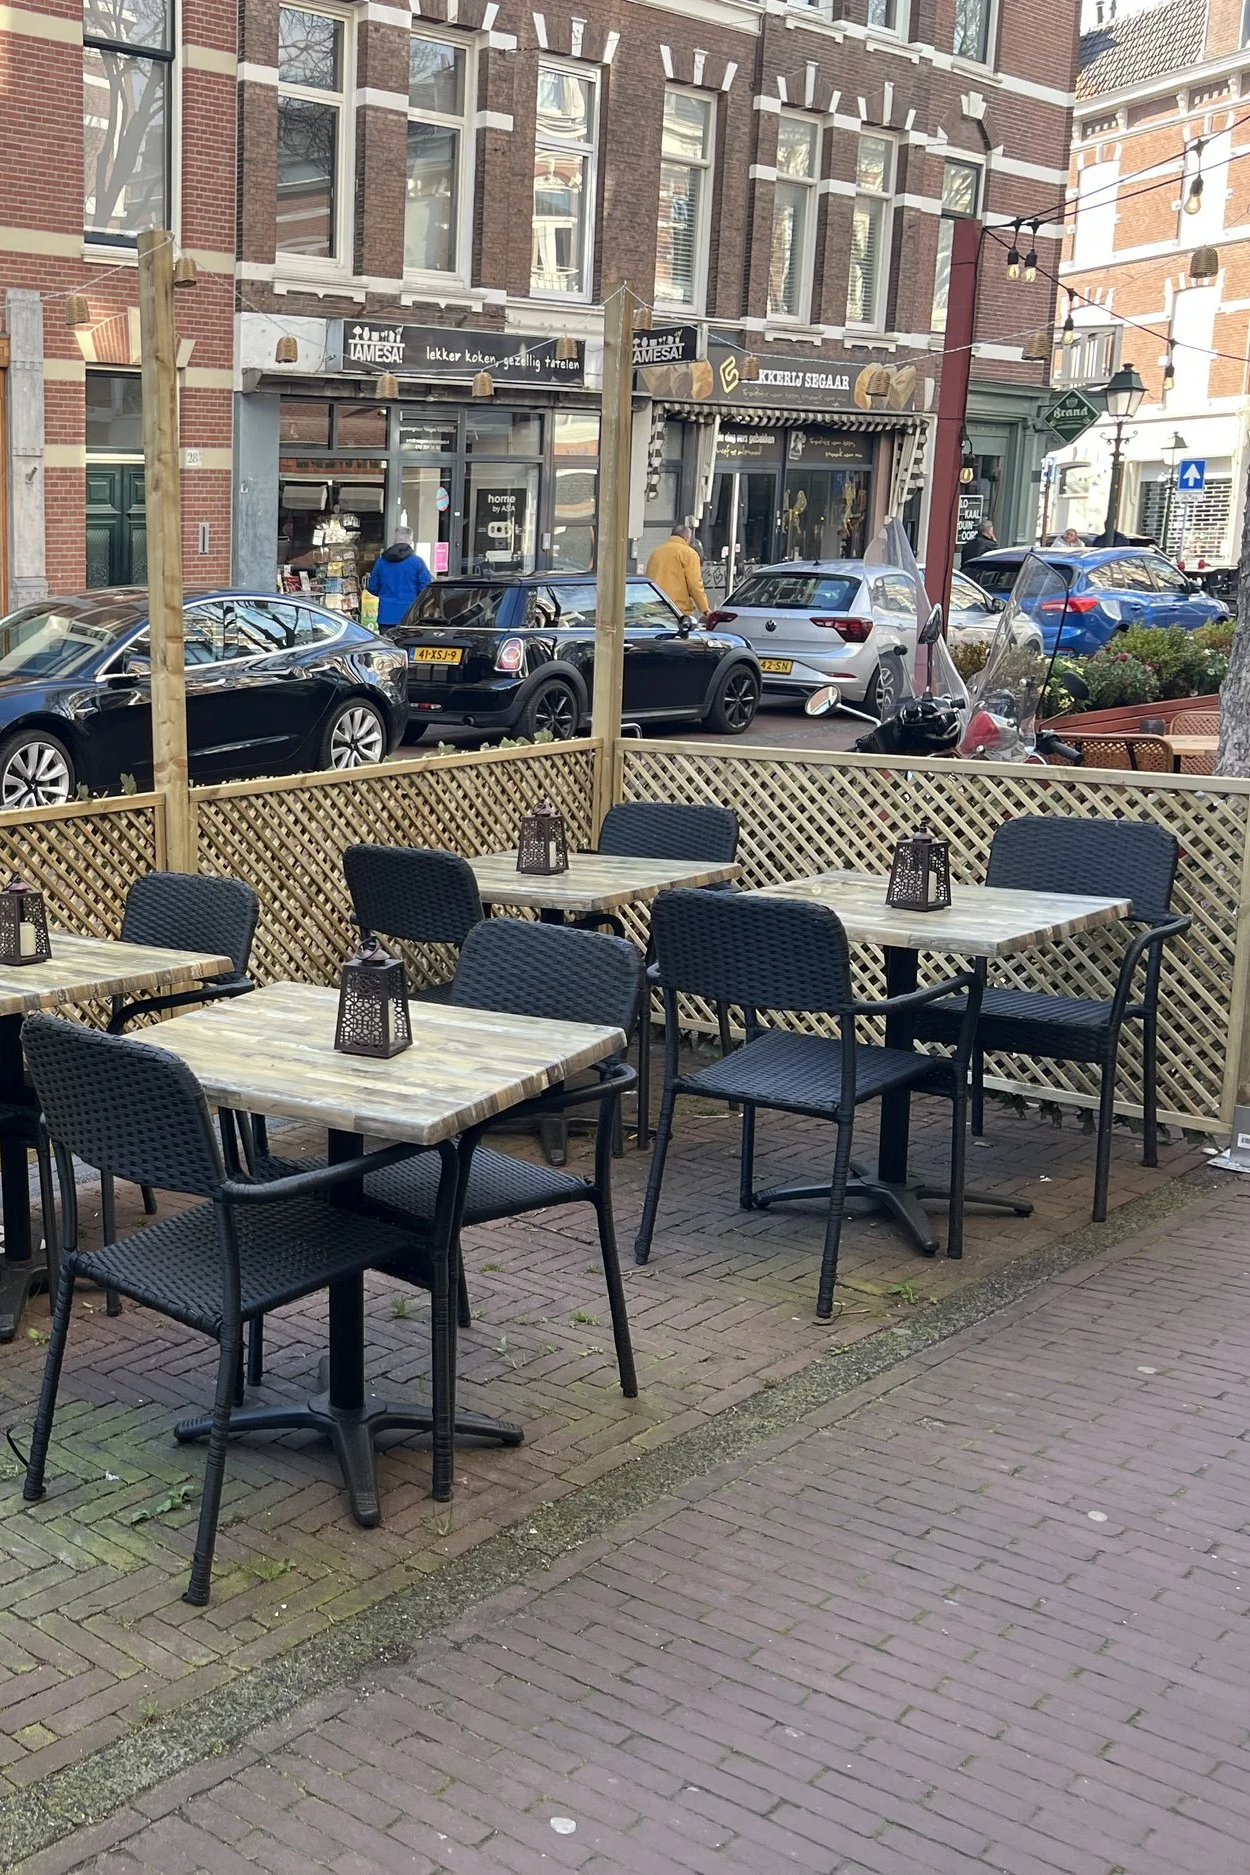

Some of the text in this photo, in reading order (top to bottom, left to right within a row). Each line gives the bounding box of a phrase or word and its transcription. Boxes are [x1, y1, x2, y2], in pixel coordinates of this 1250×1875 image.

[426, 346, 461, 361] lekker
[503, 353, 541, 372] gezellig
[632, 346, 683, 364] AMESA!
[741, 369, 850, 390] KKERIJ SEGAAR
[1053, 406, 1088, 418] Brand
[488, 494, 516, 503] home
[492, 505, 500, 513] by
[419, 650, 457, 660] 41-XSJ-9
[761, 661, 789, 671] 42-SN
